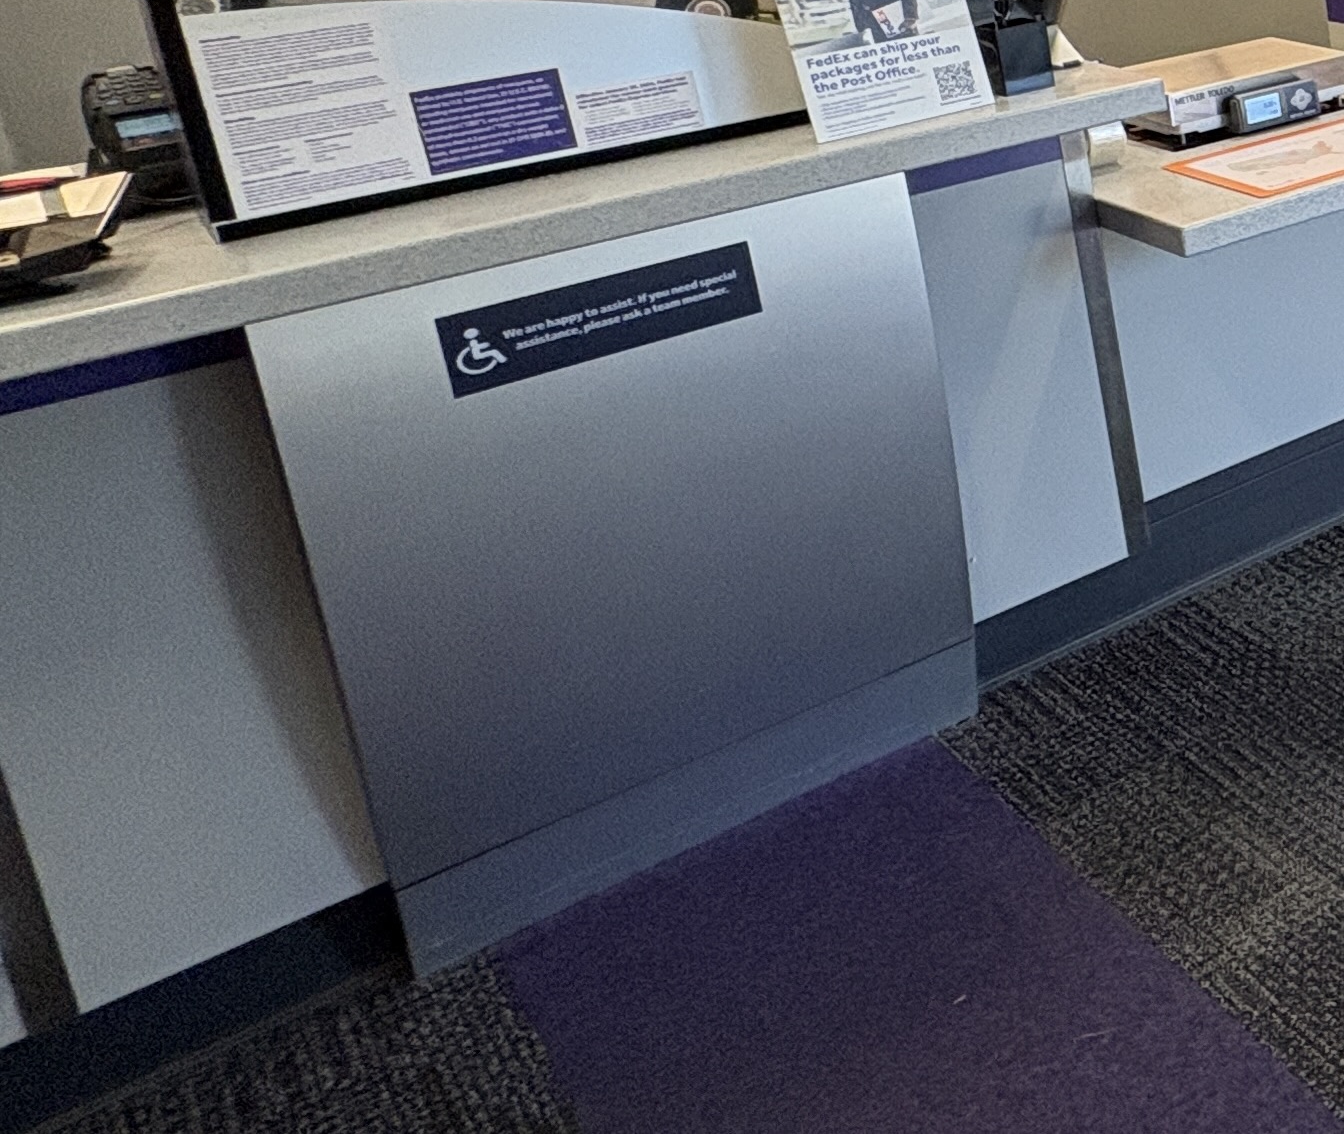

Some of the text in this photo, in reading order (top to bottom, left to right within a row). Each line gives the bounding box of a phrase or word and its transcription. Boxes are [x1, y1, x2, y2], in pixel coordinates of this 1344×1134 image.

[806, 35, 941, 69] FedEx can ship your
[810, 43, 960, 85] packages for less than
[814, 64, 921, 95] the Post Office.
[1175, 92, 1205, 106] METTLER
[503, 269, 737, 340] We are happy to assist. If you need special
[516, 288, 730, 351] assistance, please ask a team member.
